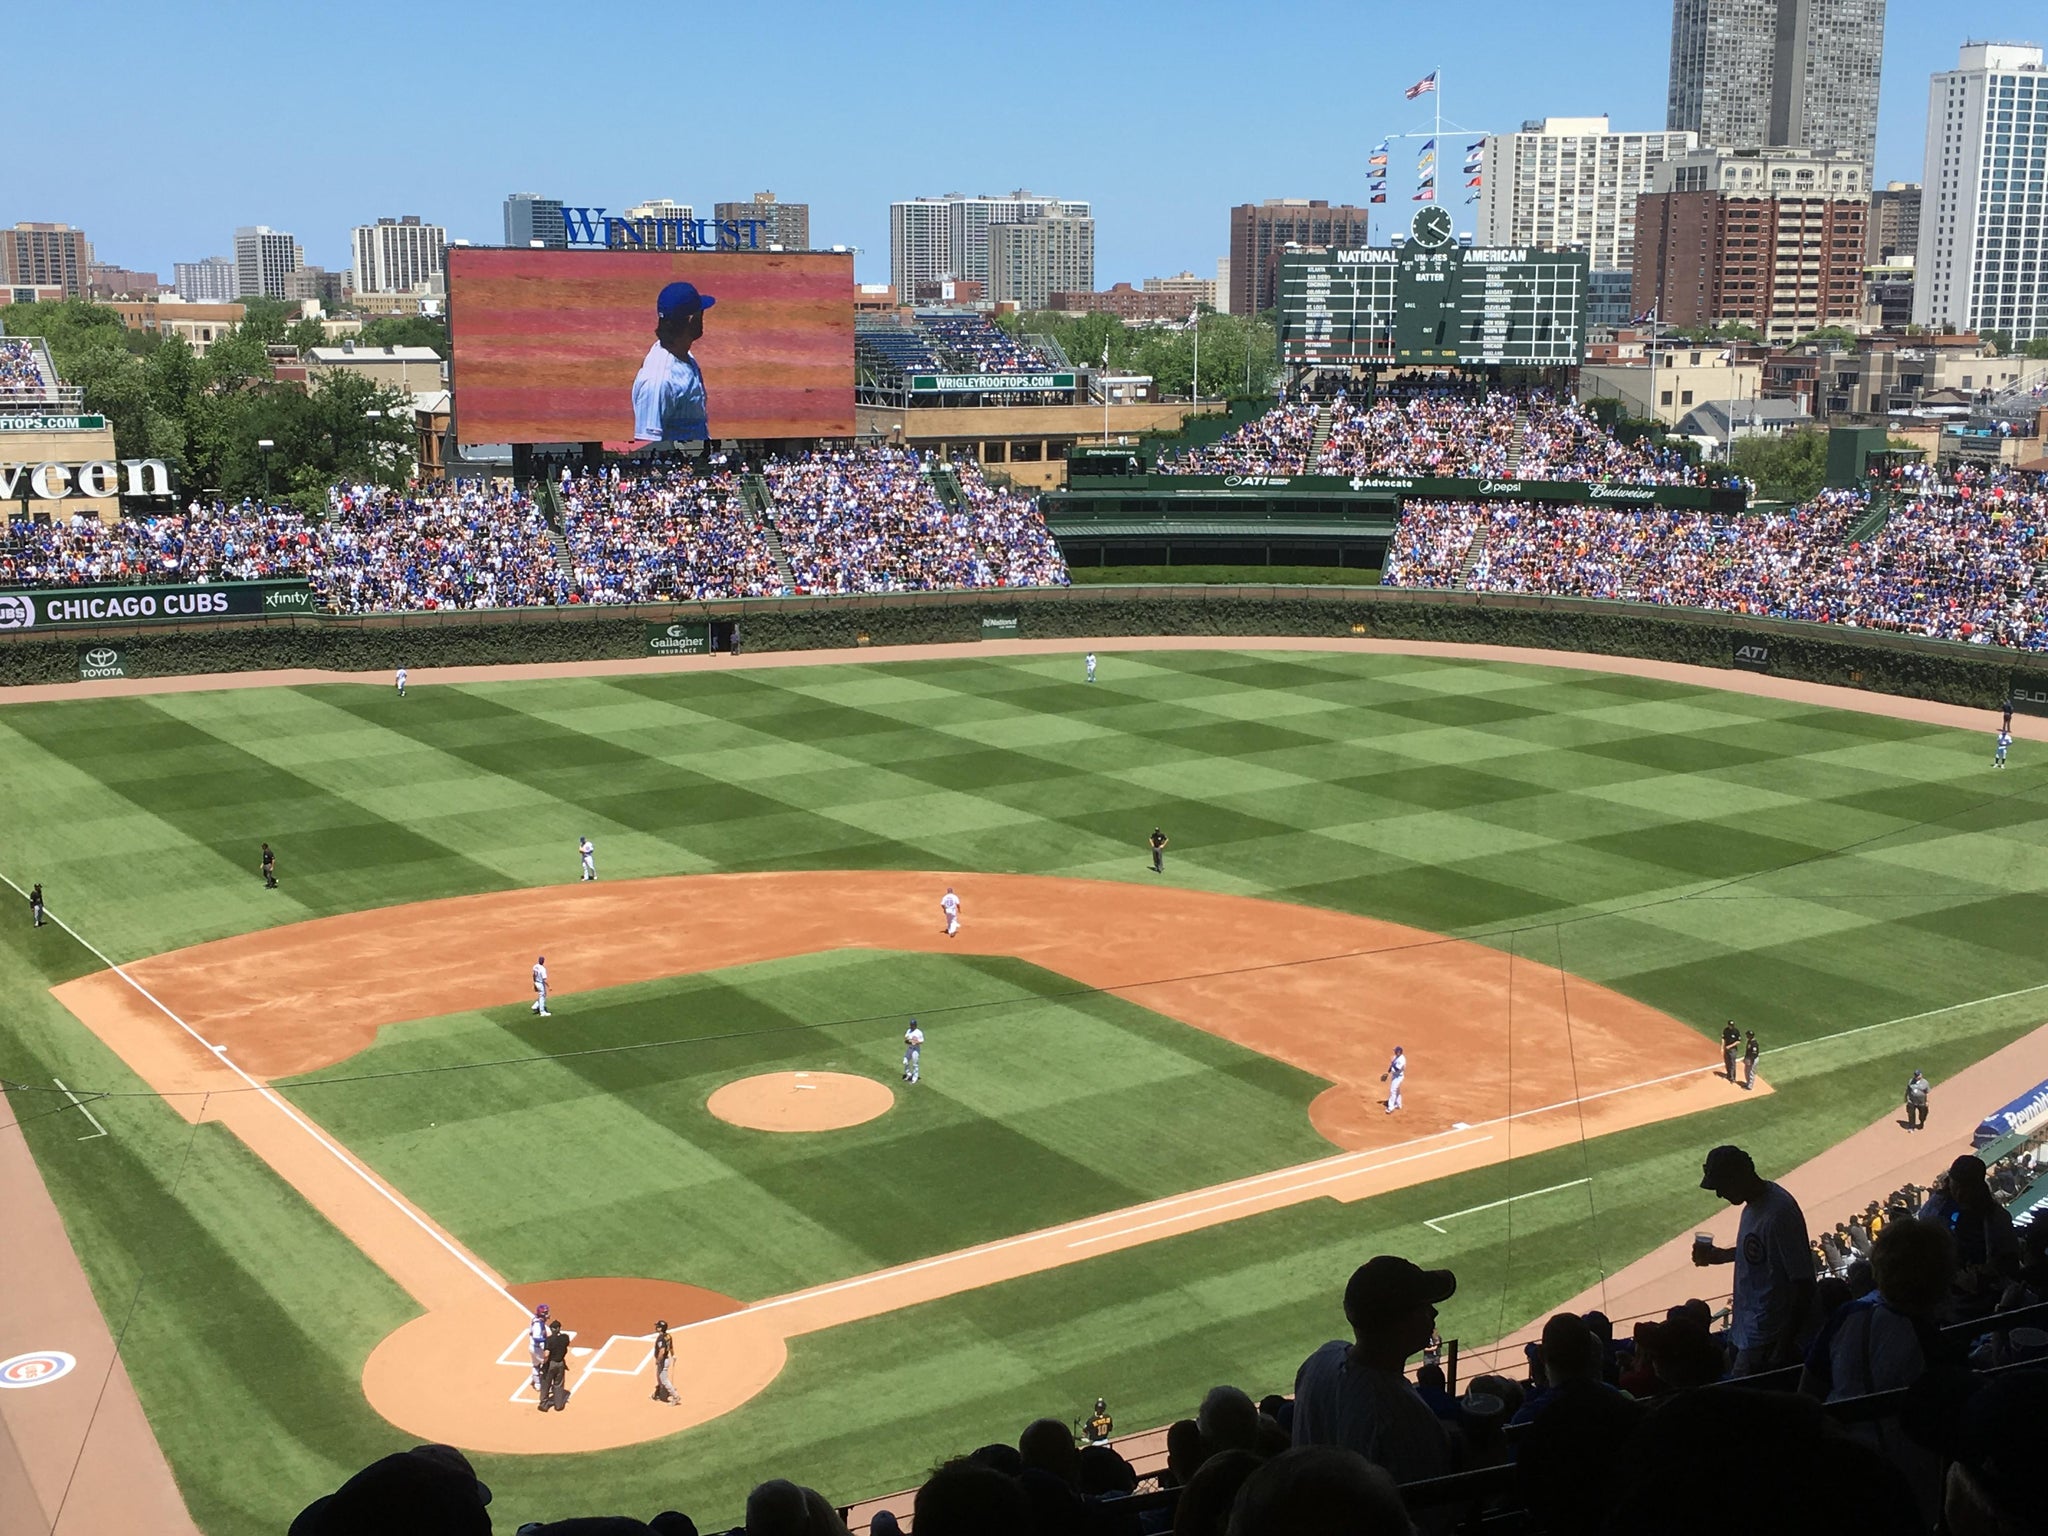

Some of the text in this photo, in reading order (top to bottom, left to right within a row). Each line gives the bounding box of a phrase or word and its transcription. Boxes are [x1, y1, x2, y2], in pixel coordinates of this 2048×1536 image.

[559, 207, 766, 248] WINTRUST
[1337, 250, 1398, 262] NATIONAL
[1463, 250, 1527, 262] AMERICAN
[1416, 273, 1444, 281] BATTER
[936, 376, 1054, 388] WRIGLEYROOFTOPS.COM
[1241, 476, 1268, 486] ATI
[1364, 478, 1413, 488] Advocate
[1493, 483, 1522, 493] pepsi
[1589, 484, 1656, 498] Budweiser
[47, 592, 228, 620] CHICAGO CUBS
[266, 592, 308, 608] xfinity
[650, 636, 704, 648] Gallagher
[1736, 645, 1768, 660] ATI
[81, 668, 124, 678] TOYOTA
